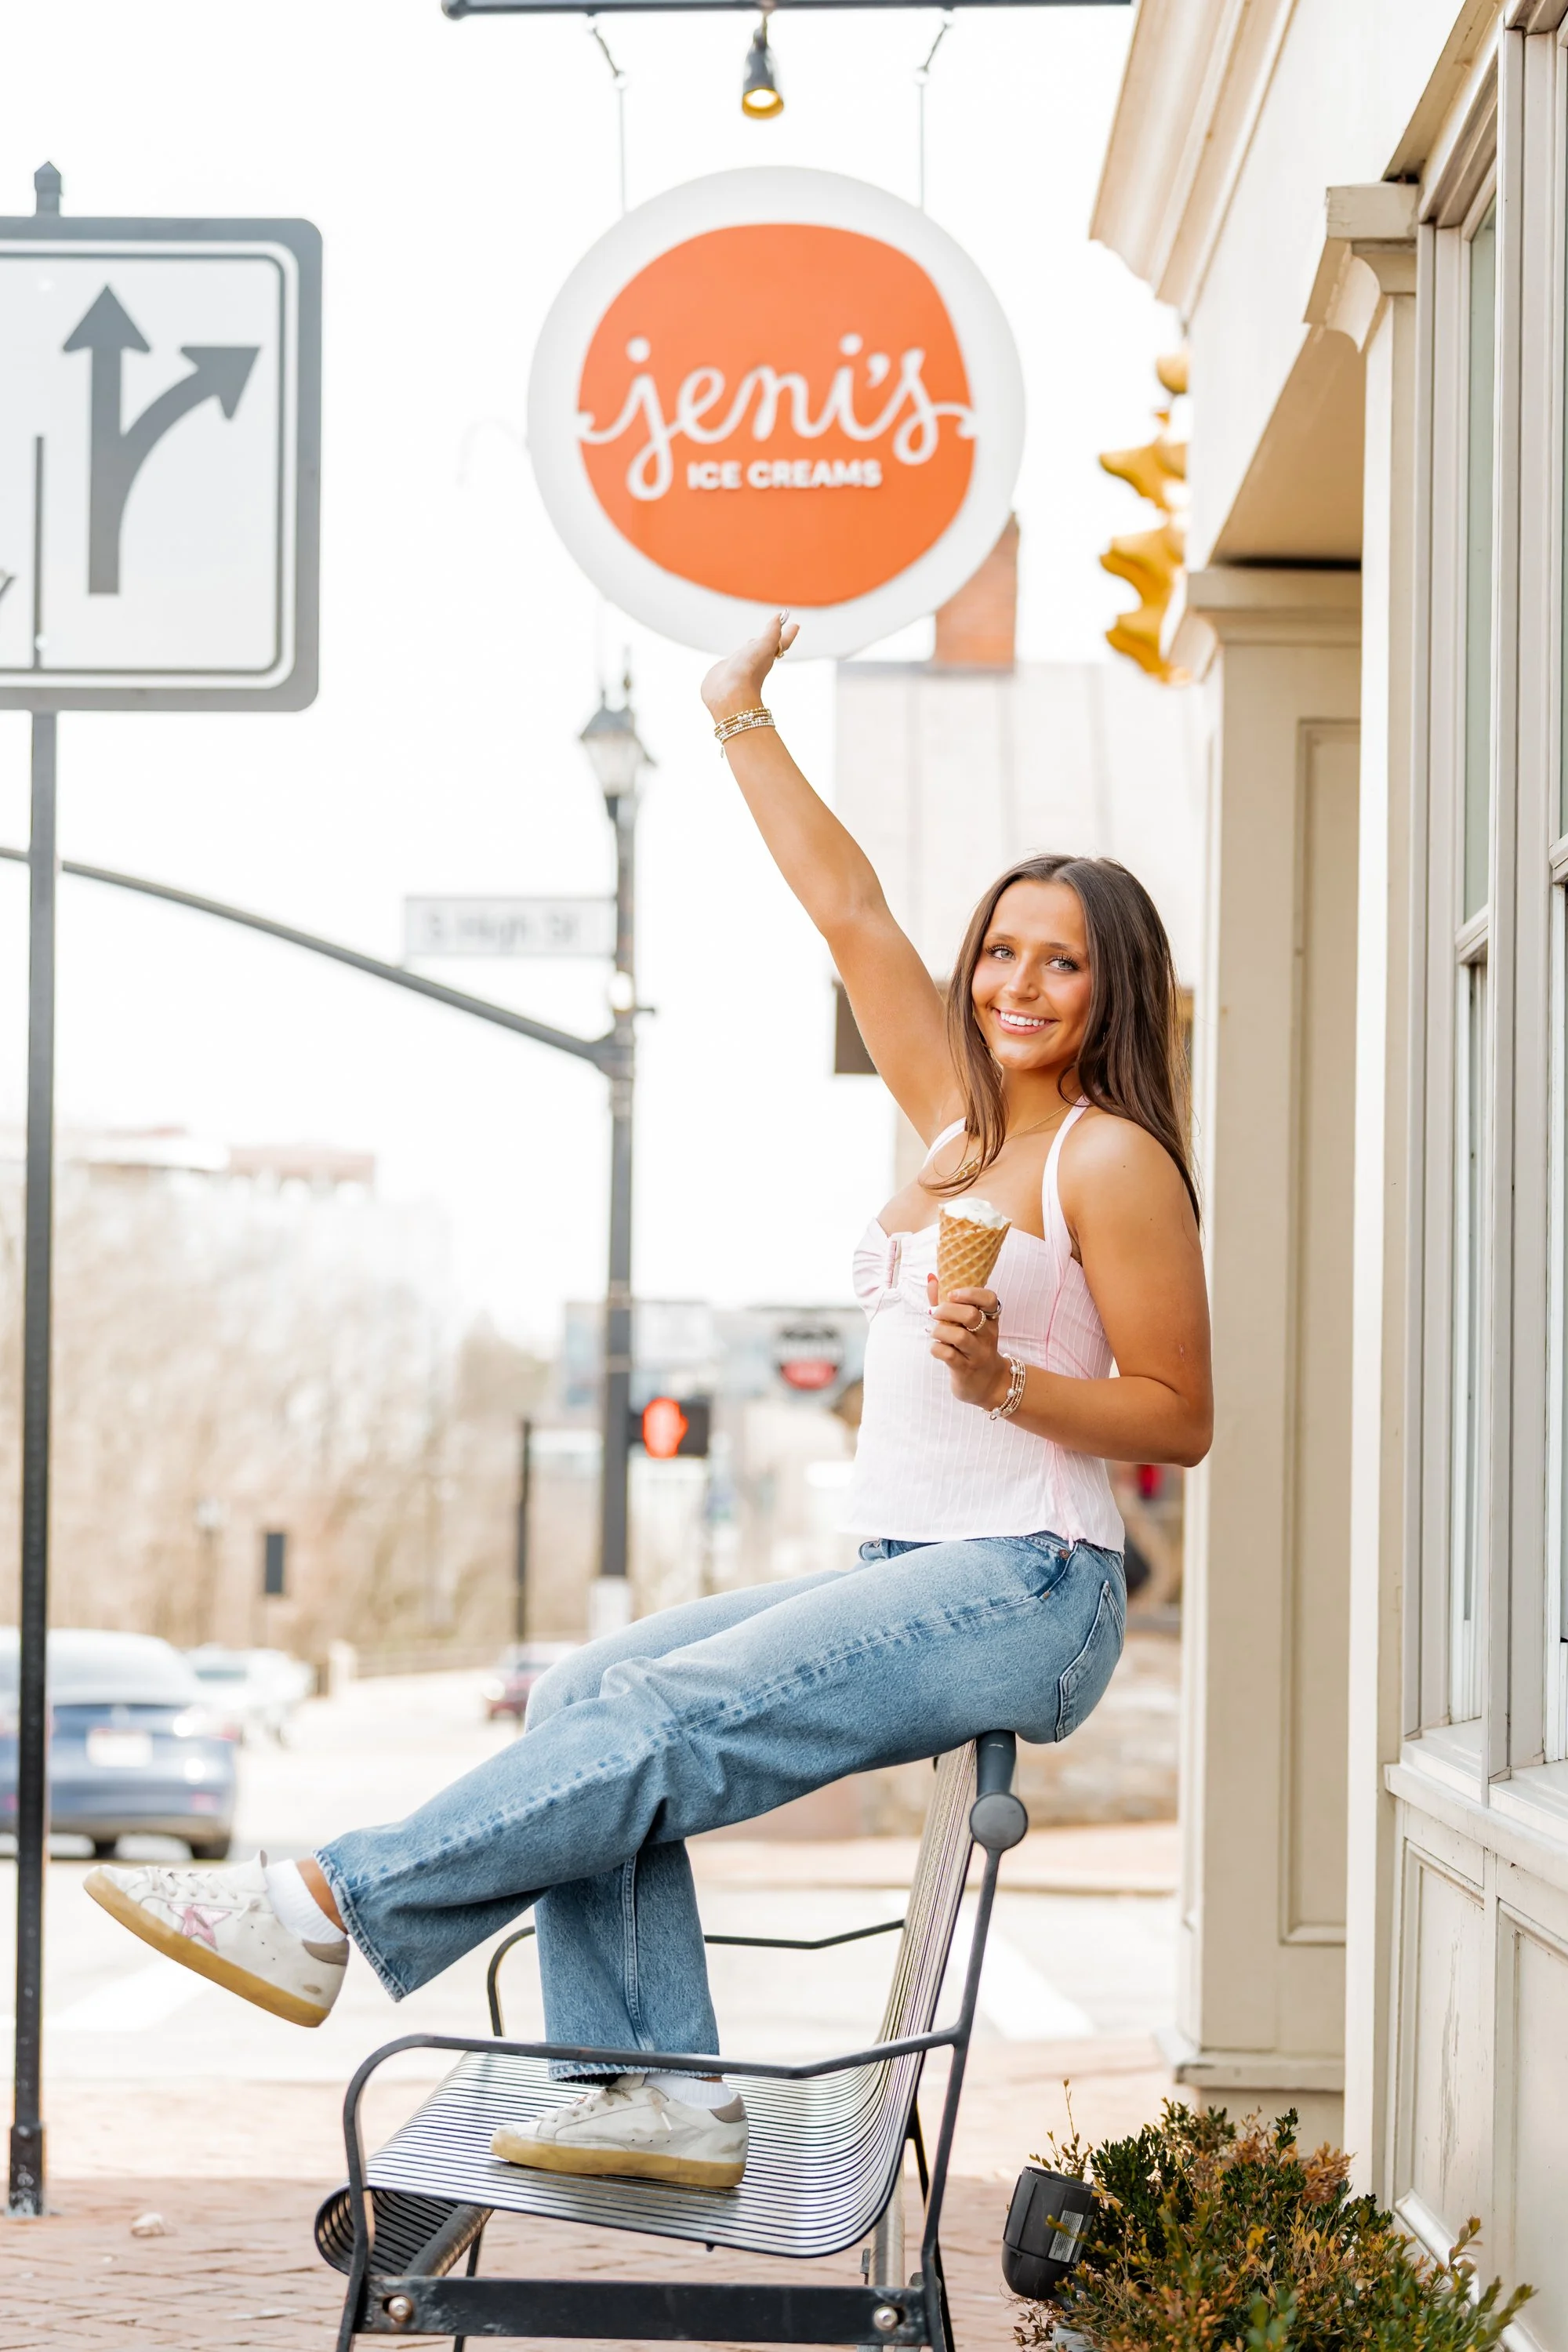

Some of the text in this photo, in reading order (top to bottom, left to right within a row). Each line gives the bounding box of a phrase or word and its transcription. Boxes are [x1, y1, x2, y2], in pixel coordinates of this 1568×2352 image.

[578, 333, 977, 501] jeni's
[687, 459, 882, 489] ICE CREAMS
